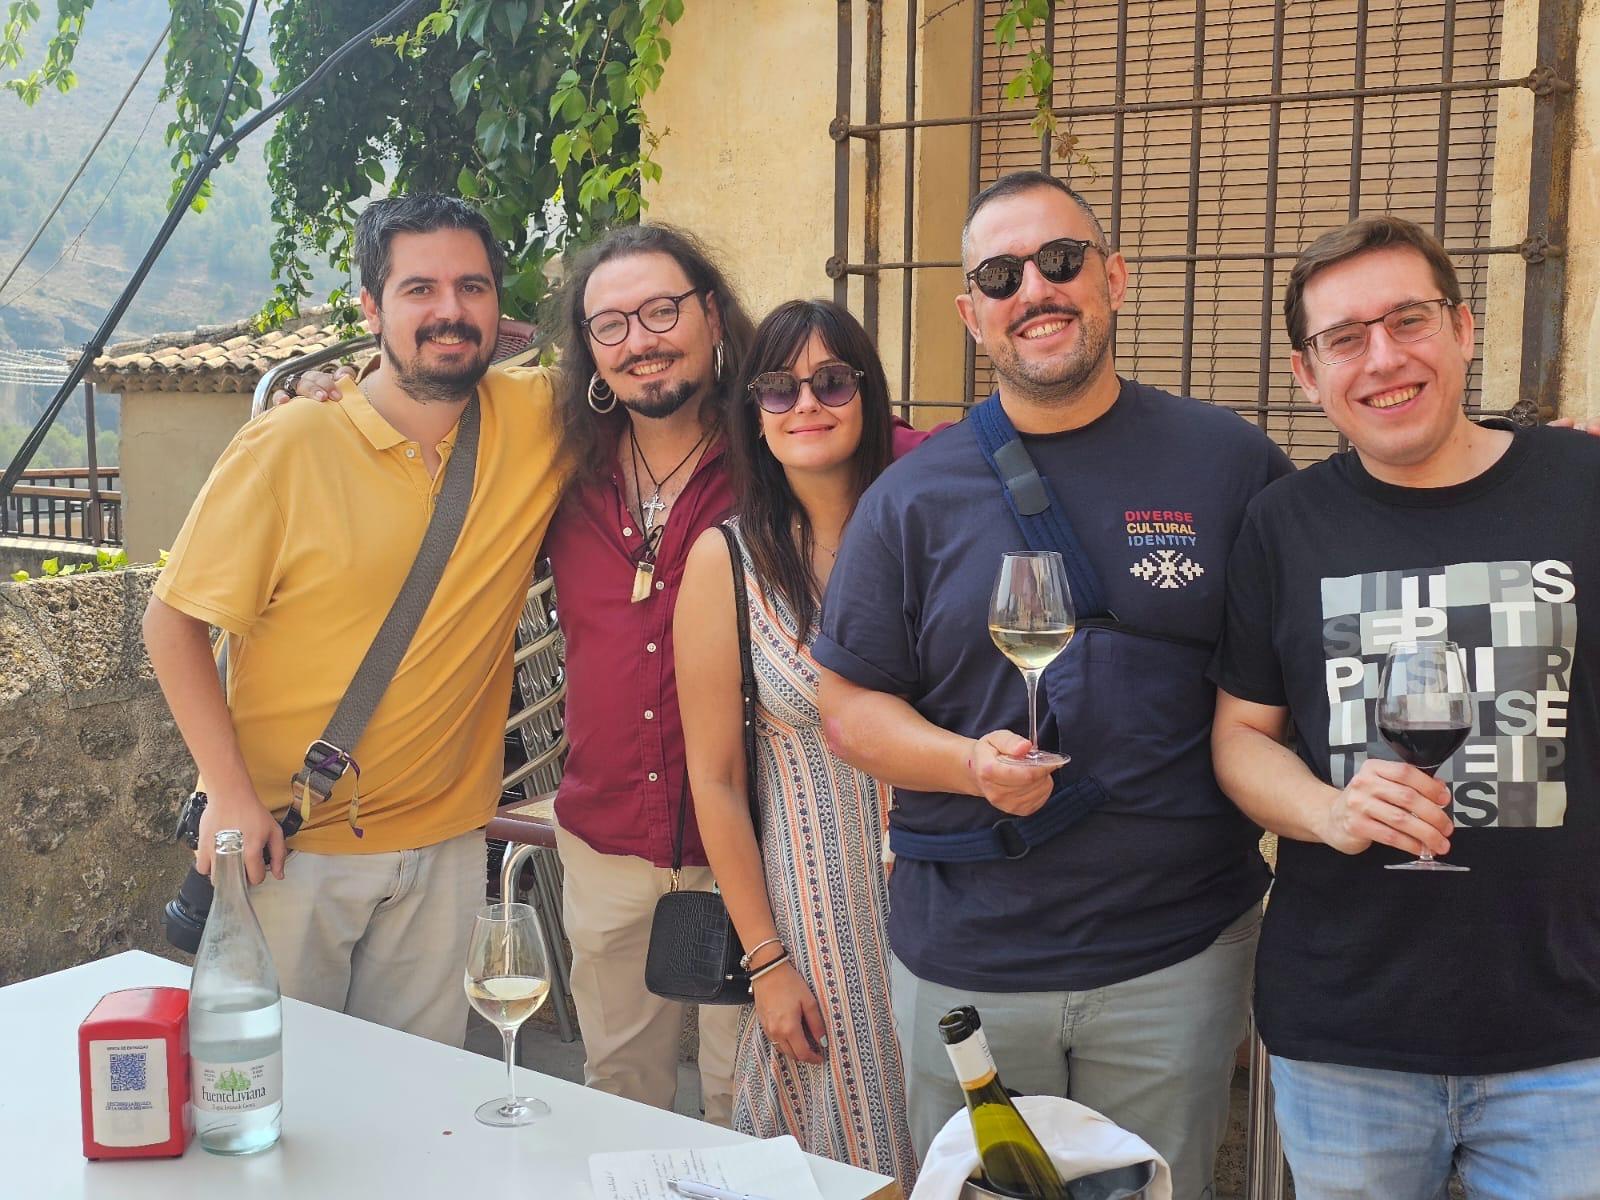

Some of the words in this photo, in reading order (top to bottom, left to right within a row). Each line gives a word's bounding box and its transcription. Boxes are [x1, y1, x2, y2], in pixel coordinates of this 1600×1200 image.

[1124, 511, 1194, 522] DIVERSE
[1126, 522, 1196, 534] CULTURAL
[1128, 535, 1197, 547] IDENTITY
